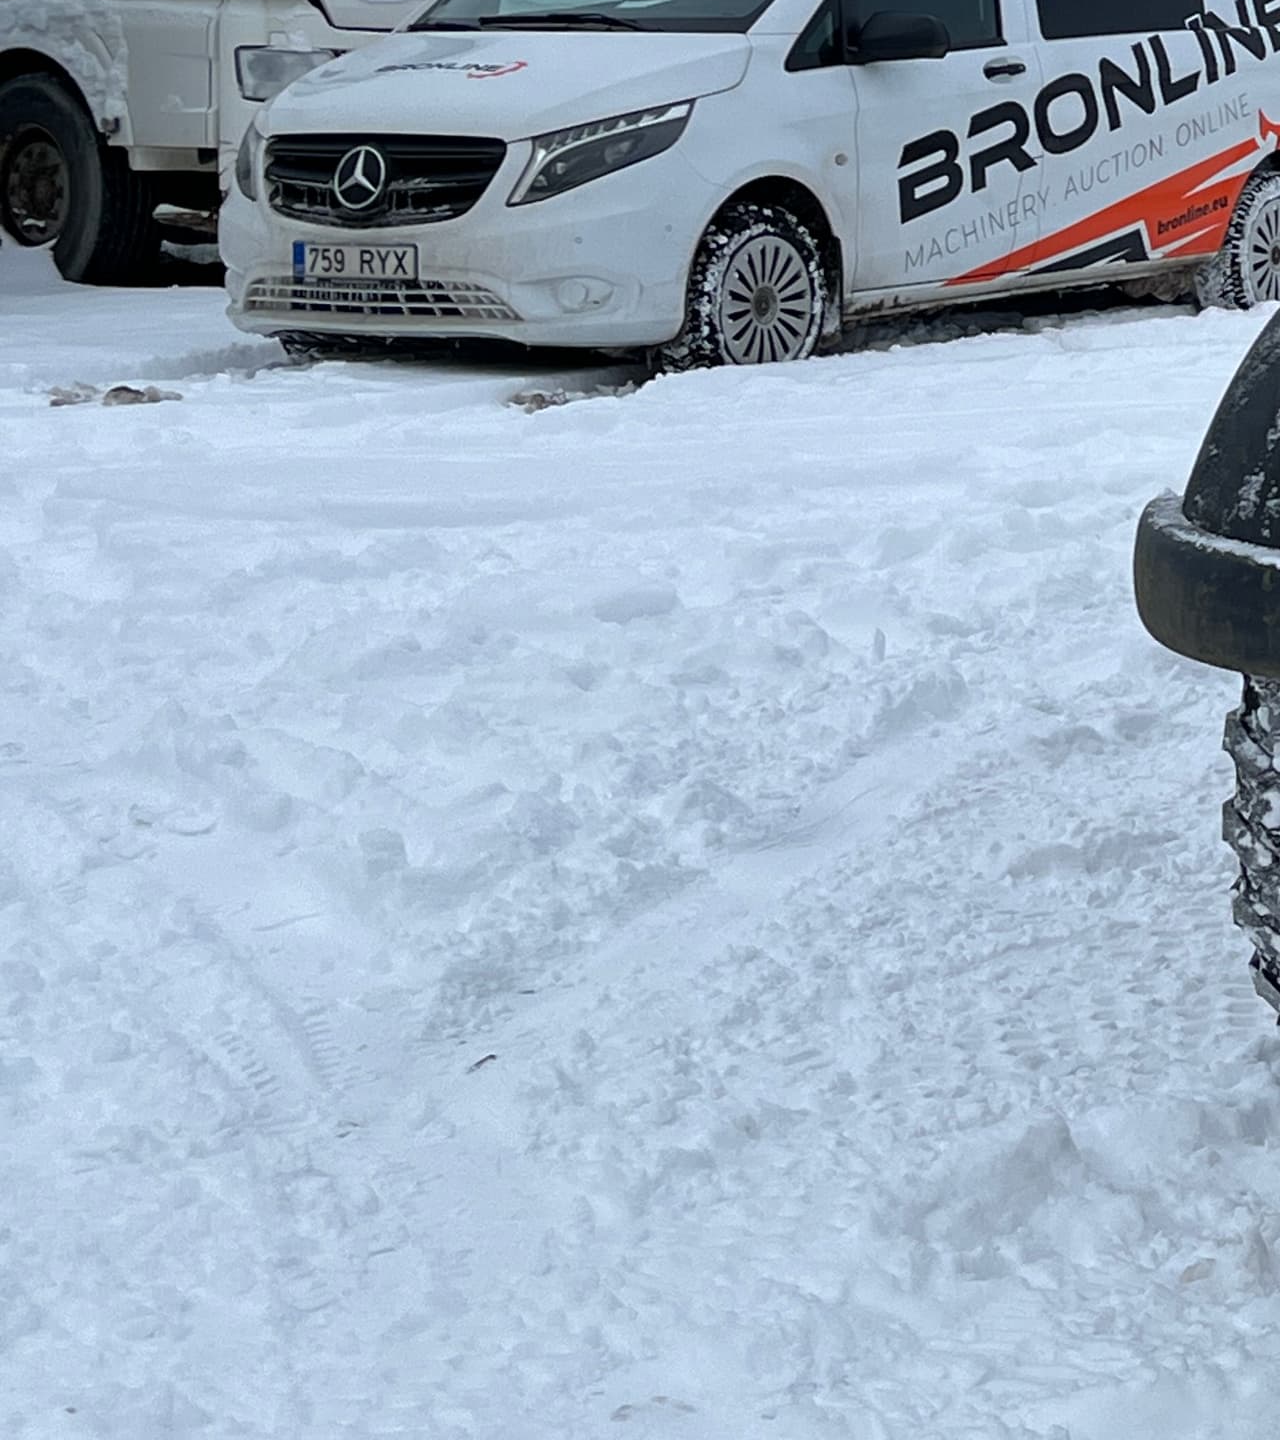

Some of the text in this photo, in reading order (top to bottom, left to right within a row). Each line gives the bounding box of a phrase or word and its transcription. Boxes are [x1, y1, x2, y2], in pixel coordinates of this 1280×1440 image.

[903, 93, 1250, 273] MACHINERY. AUCTION. ONLINE
[1157, 195, 1228, 235] bronline.eu
[309, 247, 408, 275] 759 RYX
